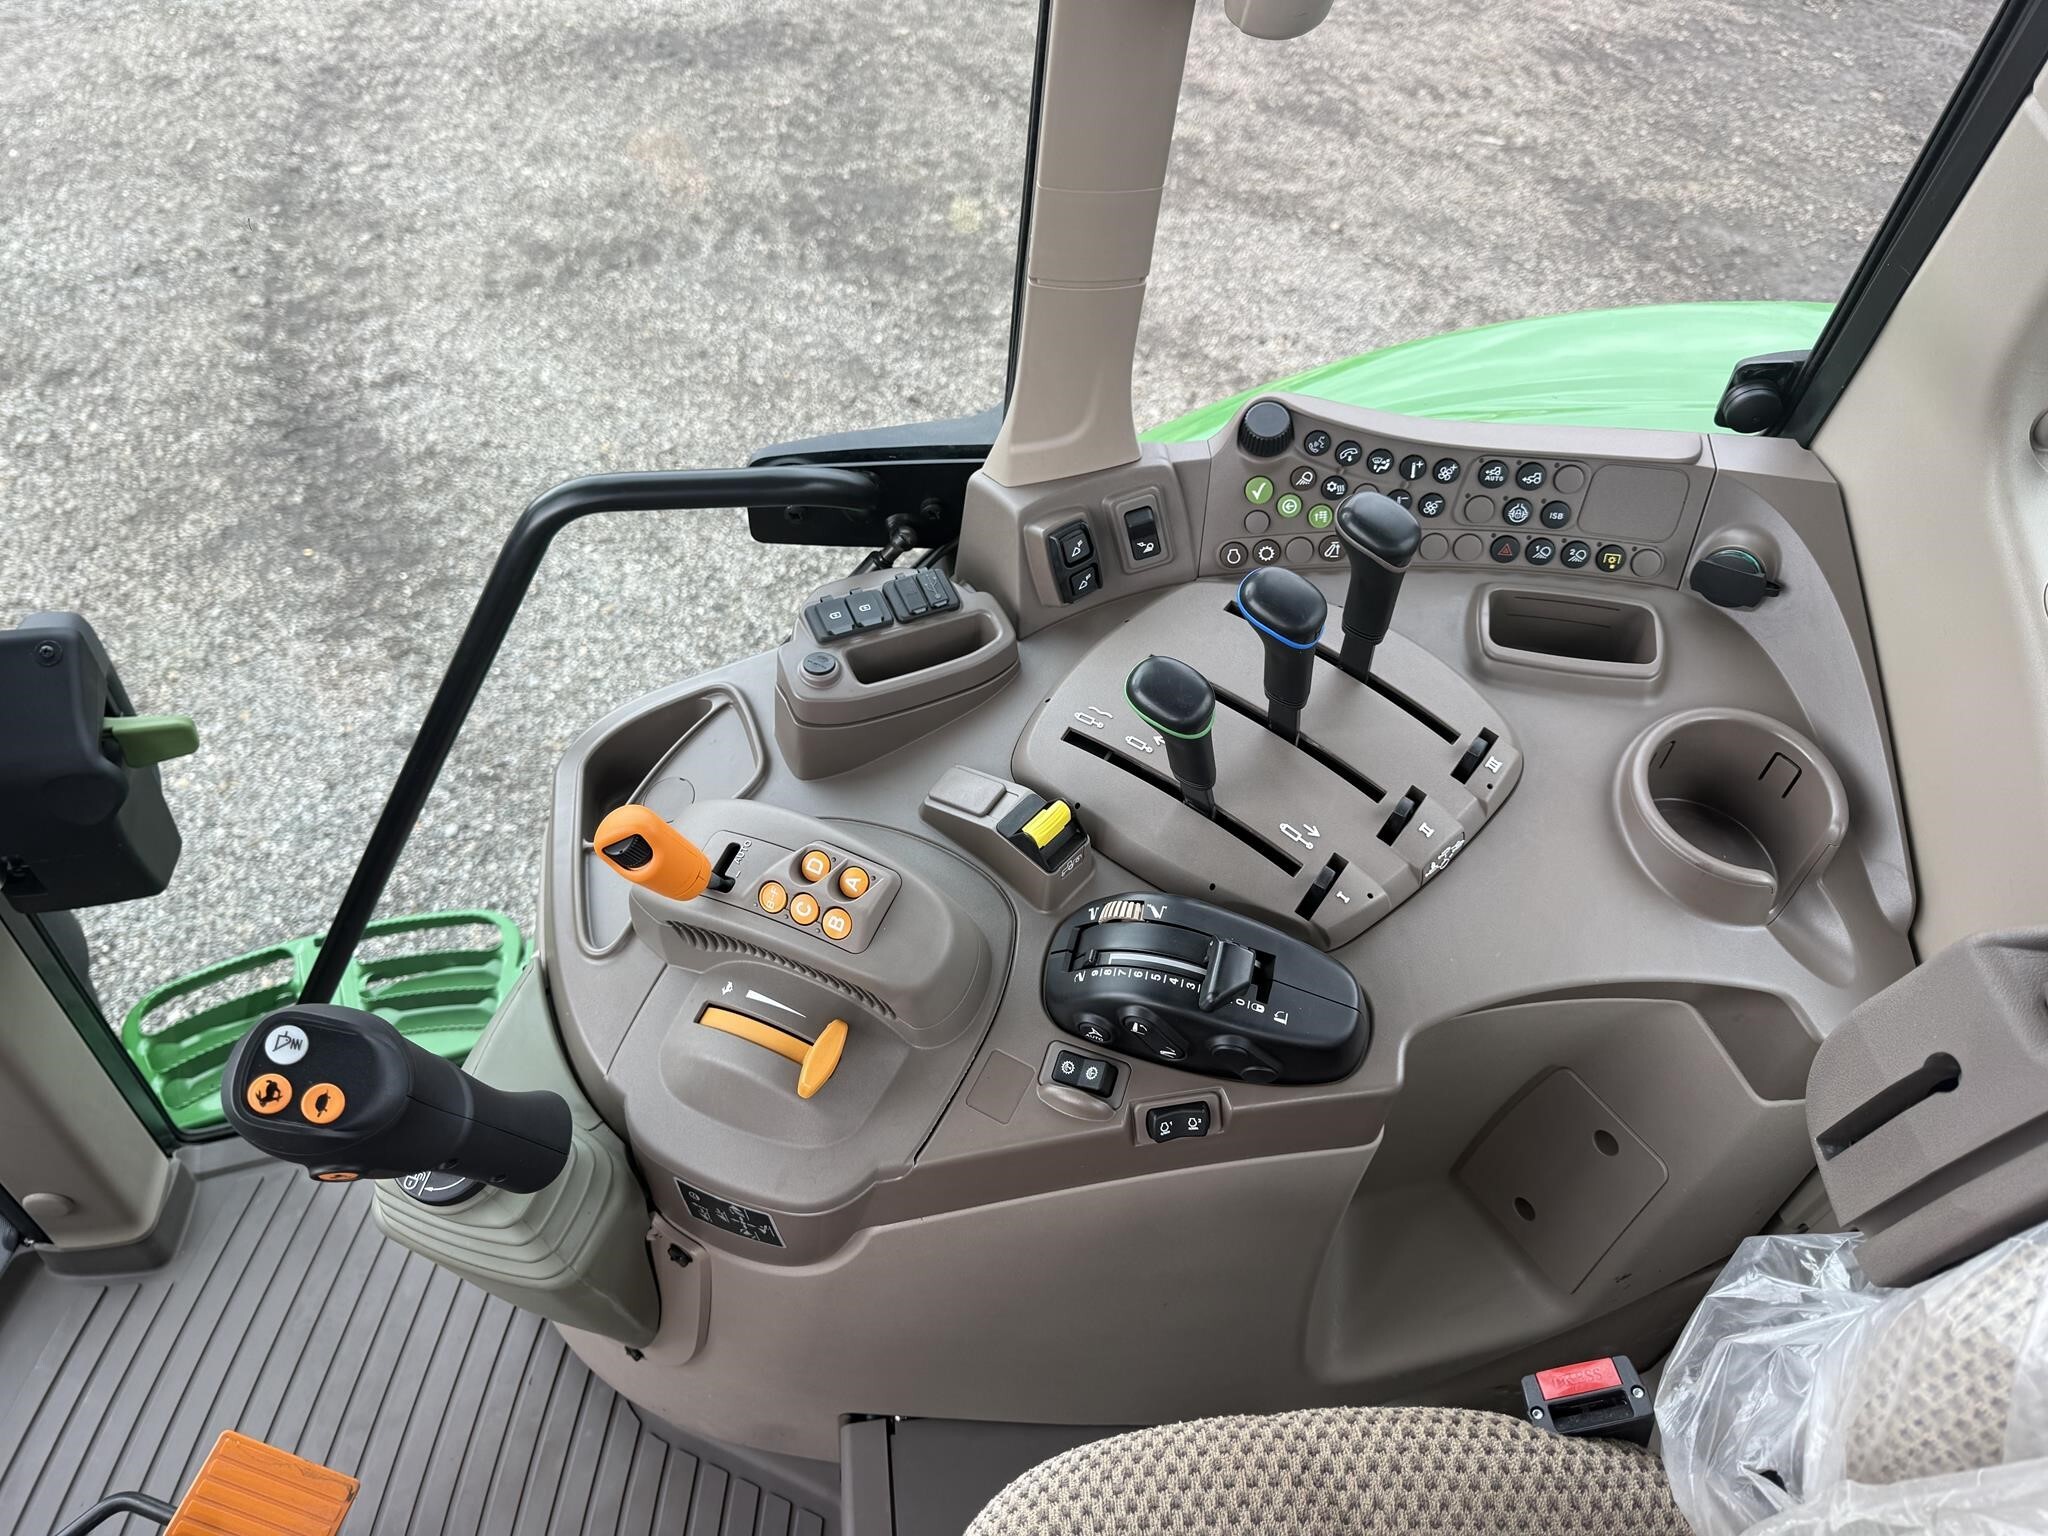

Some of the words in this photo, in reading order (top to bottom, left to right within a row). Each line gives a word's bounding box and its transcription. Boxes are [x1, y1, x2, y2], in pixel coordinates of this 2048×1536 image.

[1549, 512, 1564, 520] ISB
[733, 839, 752, 865] AUTO
[806, 857, 824, 875] D
[845, 877, 862, 892] A
[796, 901, 812, 917] C
[828, 916, 845, 932] B
[1091, 969, 1098, 977] 9
[1133, 970, 1143, 978] 6
[1151, 974, 1161, 982] 5
[1169, 977, 1179, 985] 4
[1186, 982, 1196, 990] 3
[1236, 998, 1245, 1006] 0
[1085, 1033, 1104, 1042] AUTO
[1551, 1367, 1602, 1388] PRESS
